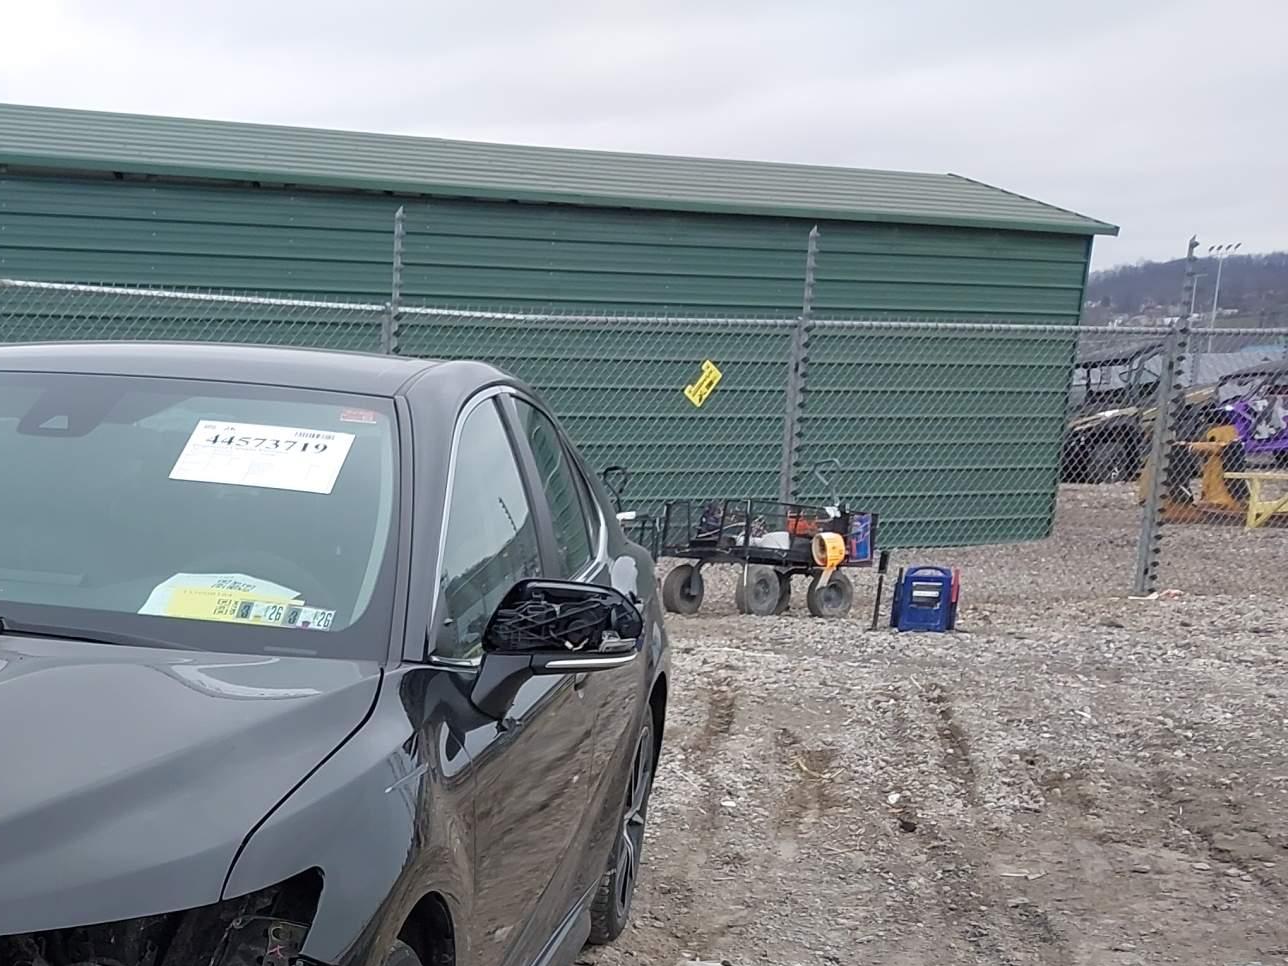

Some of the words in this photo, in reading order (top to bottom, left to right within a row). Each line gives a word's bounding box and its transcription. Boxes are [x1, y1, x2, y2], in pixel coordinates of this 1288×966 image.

[205, 433, 328, 454] 44573719
[241, 605, 251, 619] 3
[268, 604, 284, 622] 26
[288, 610, 299, 625] 3
[317, 610, 333, 628] 26
